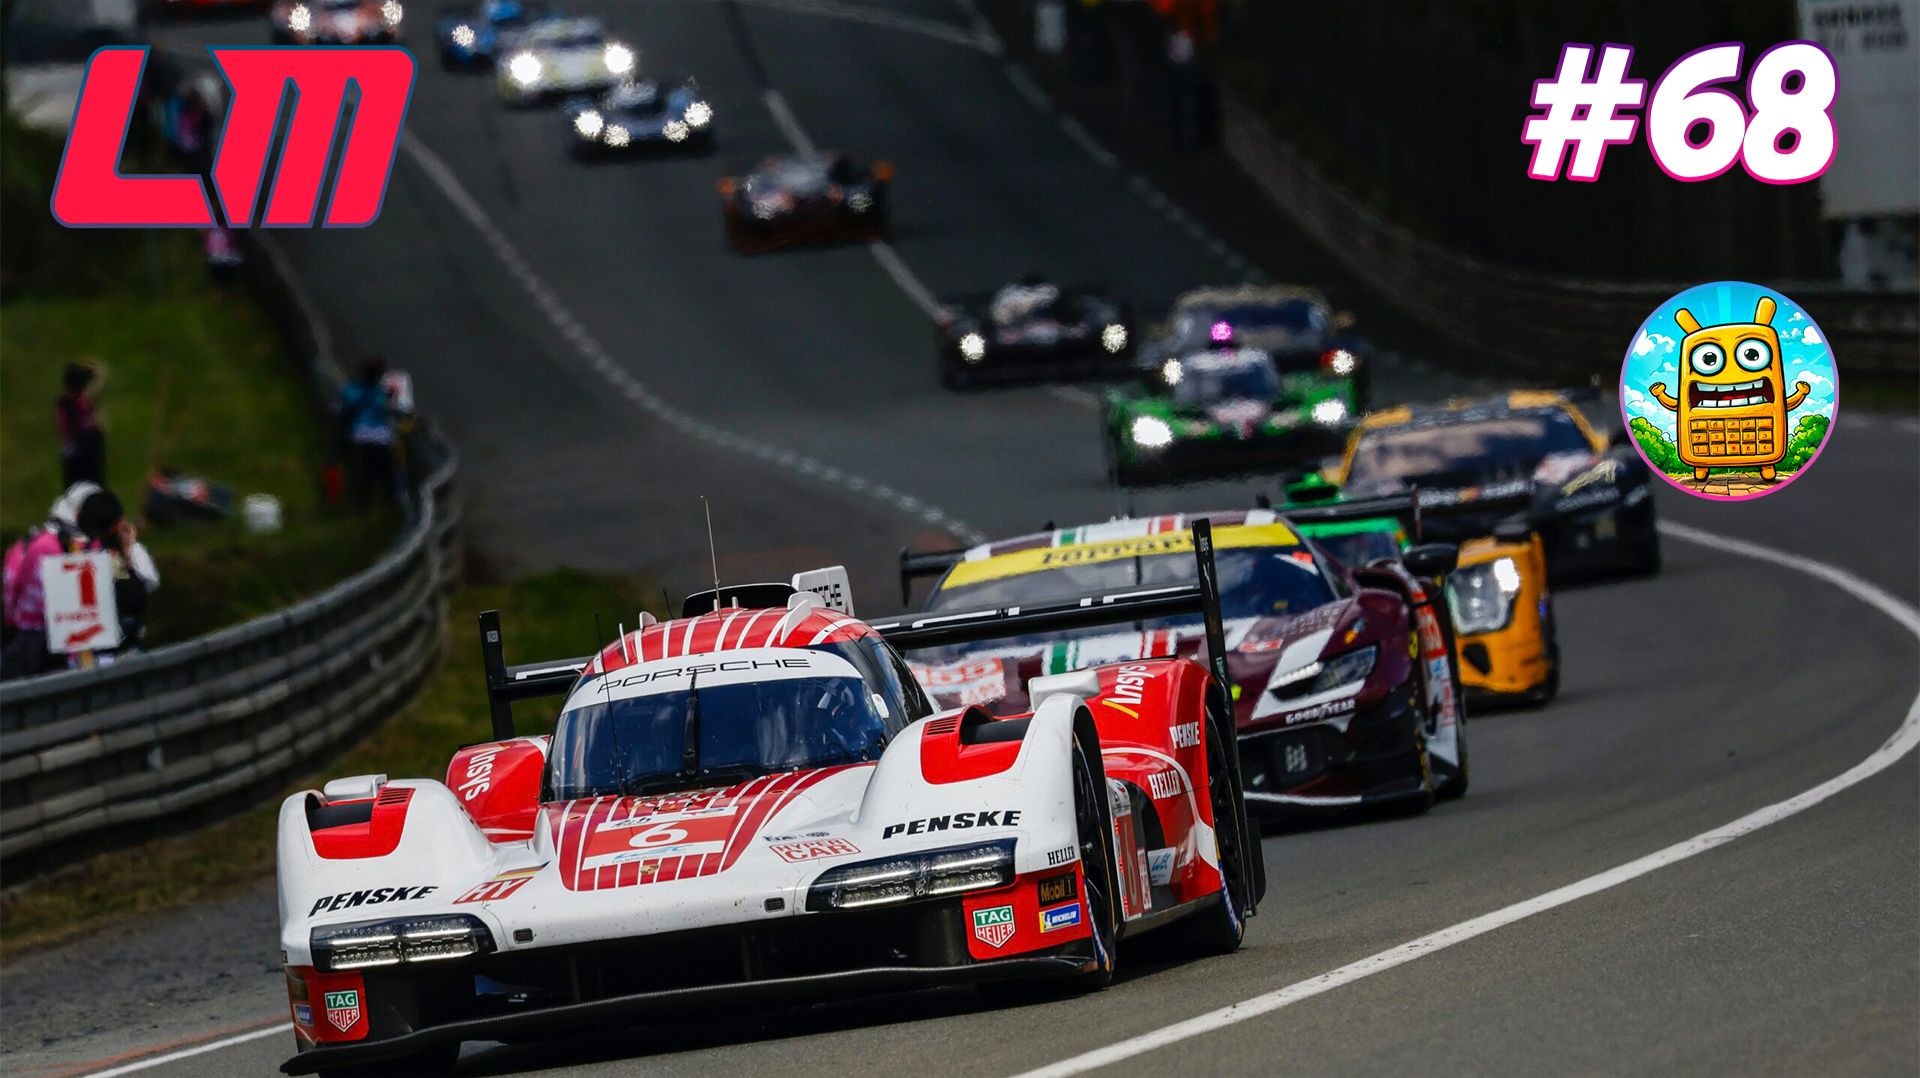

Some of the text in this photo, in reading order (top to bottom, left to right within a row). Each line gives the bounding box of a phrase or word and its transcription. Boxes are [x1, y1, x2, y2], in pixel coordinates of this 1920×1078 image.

[597, 658, 812, 695] PORSCHE
[1285, 699, 1356, 725] GOODYEAR
[1169, 720, 1201, 750] PENSKE
[628, 822, 688, 848] 6
[882, 810, 1022, 840] PENSKE
[776, 839, 844, 852] HYPER
[784, 846, 853, 860] CAR
[308, 886, 439, 918] PENSKE
[1040, 879, 1074, 903] Mobil 1
[977, 909, 1010, 925] TAG
[977, 923, 1013, 945] HEUER
[328, 993, 355, 1008] TAG
[329, 1009, 358, 1029] HEUER
